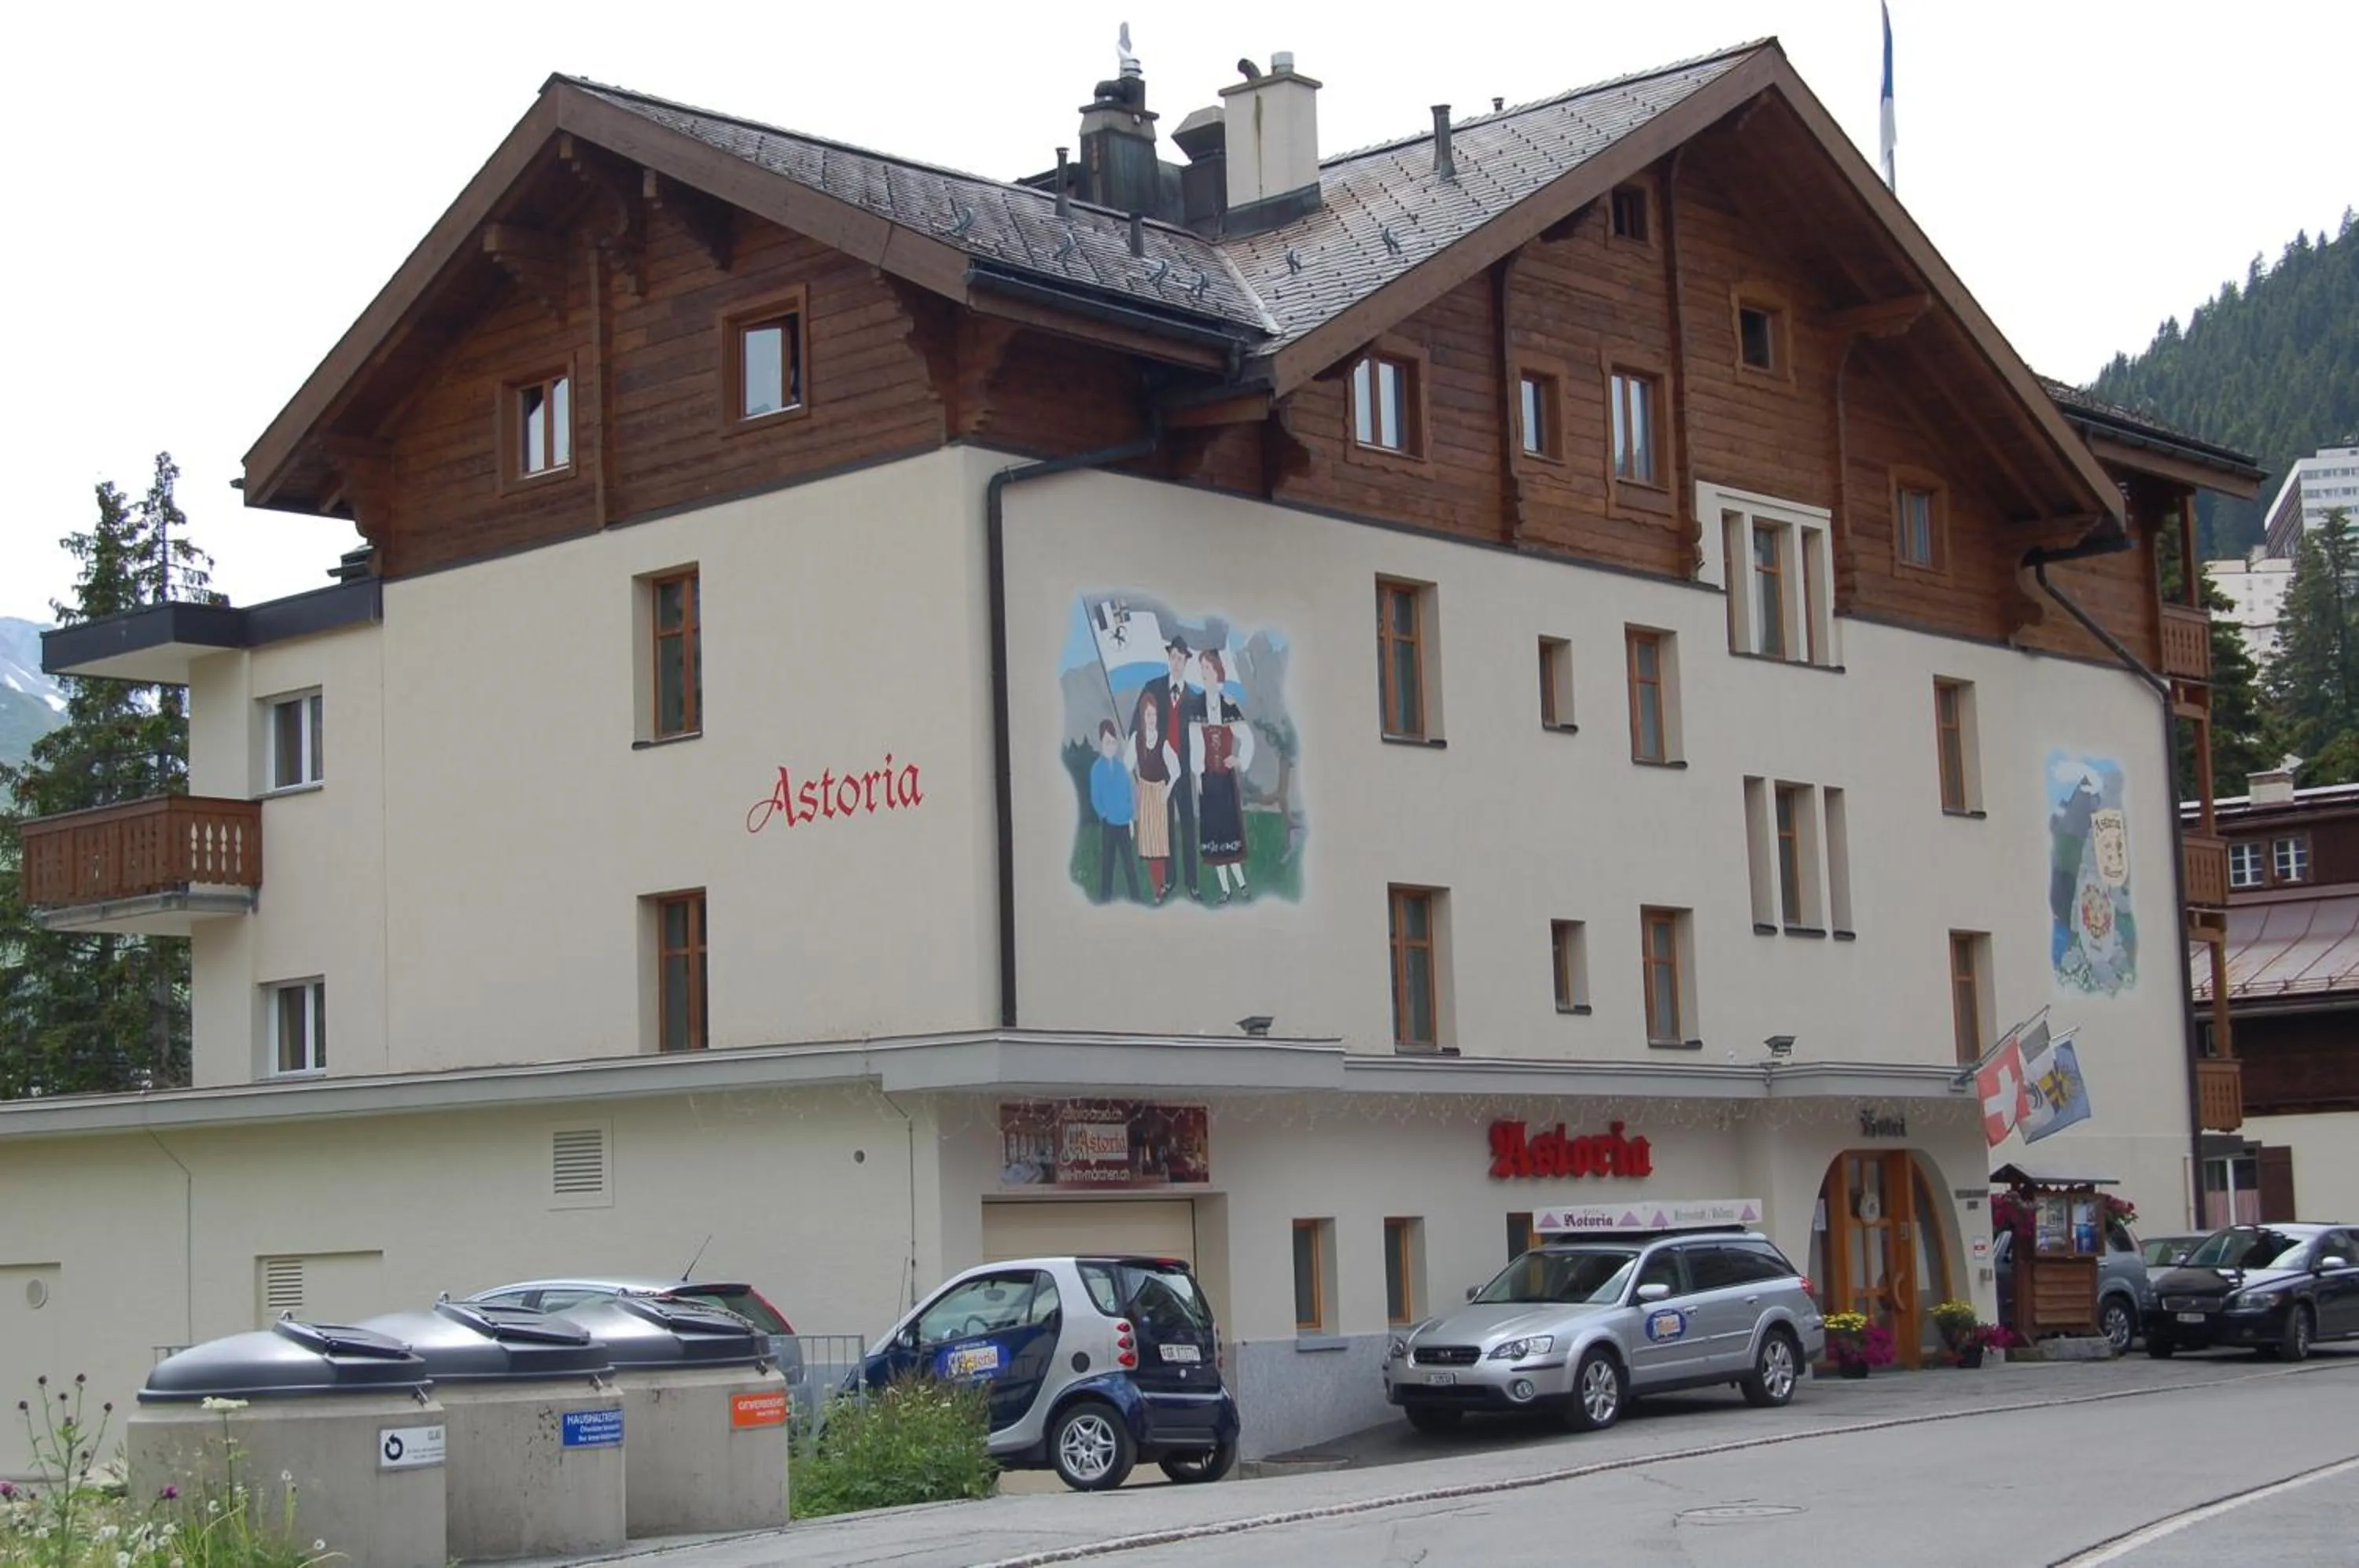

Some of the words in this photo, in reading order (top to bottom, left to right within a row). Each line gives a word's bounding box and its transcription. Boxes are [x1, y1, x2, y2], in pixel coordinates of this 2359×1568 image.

[747, 753, 923, 834] Astoria
[1489, 1120, 1653, 1178] Astoria
[1564, 1213, 1614, 1227] Astoria
